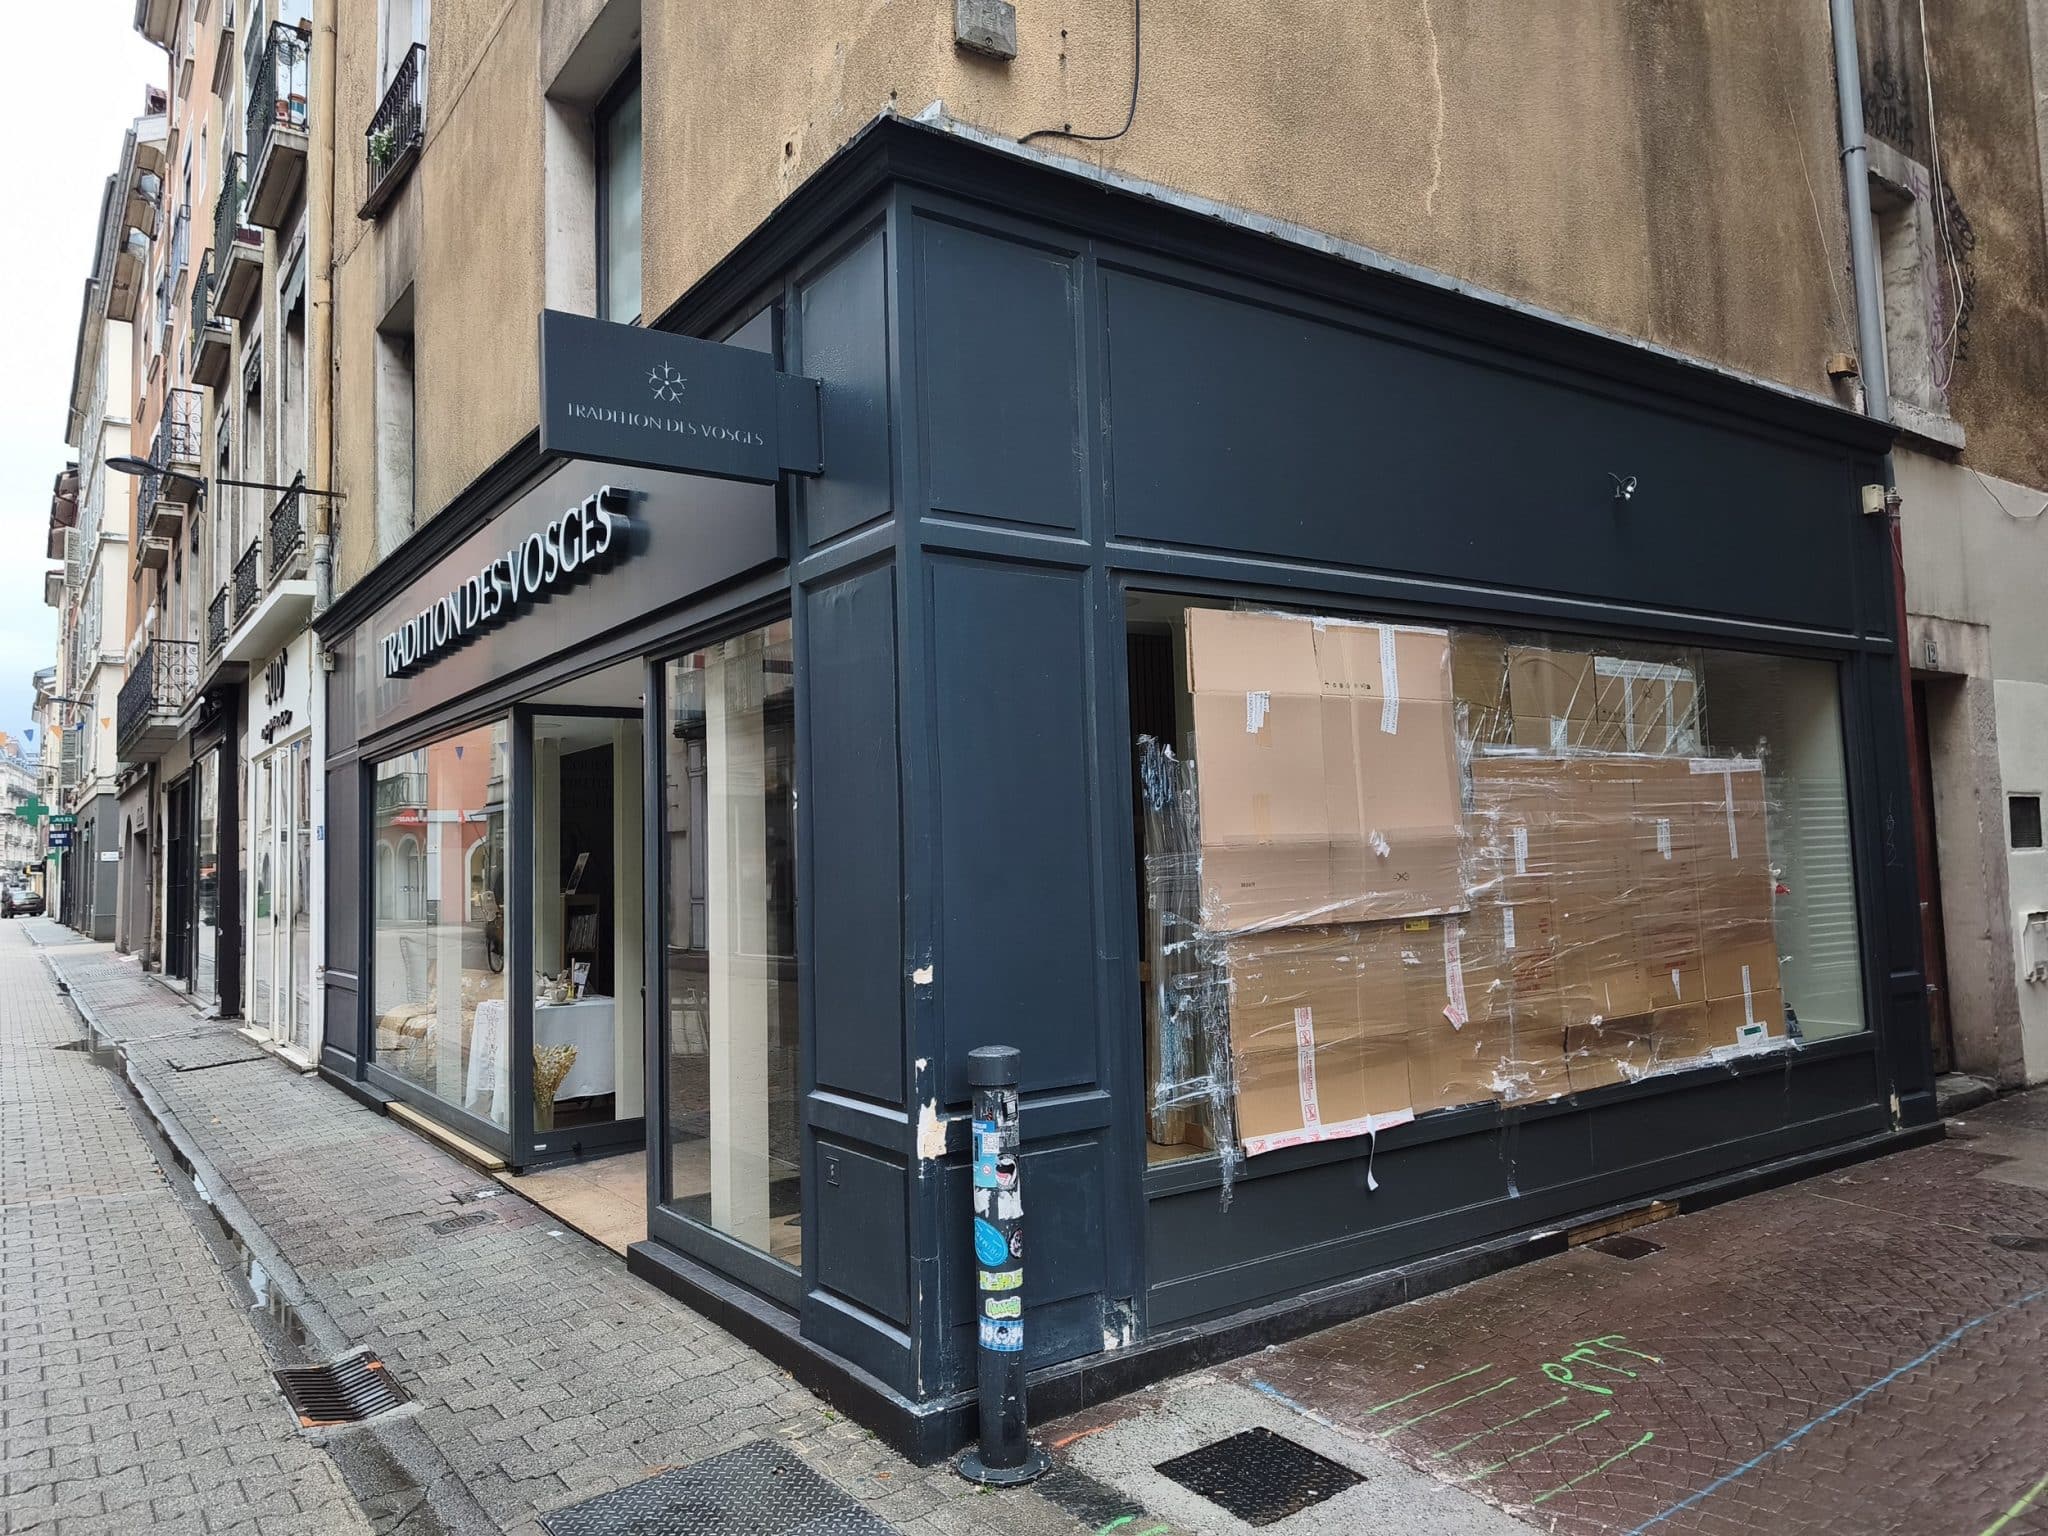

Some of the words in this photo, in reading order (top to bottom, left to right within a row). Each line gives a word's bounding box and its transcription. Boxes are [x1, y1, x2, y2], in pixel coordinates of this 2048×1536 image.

[567, 402, 662, 430] TRADITION
[666, 418, 697, 435] DES
[700, 423, 764, 446] VOSGES
[380, 589, 461, 678] TRADITION
[466, 558, 503, 629] DES
[507, 485, 620, 603] VOSGES
[1927, 644, 1937, 664] 12
